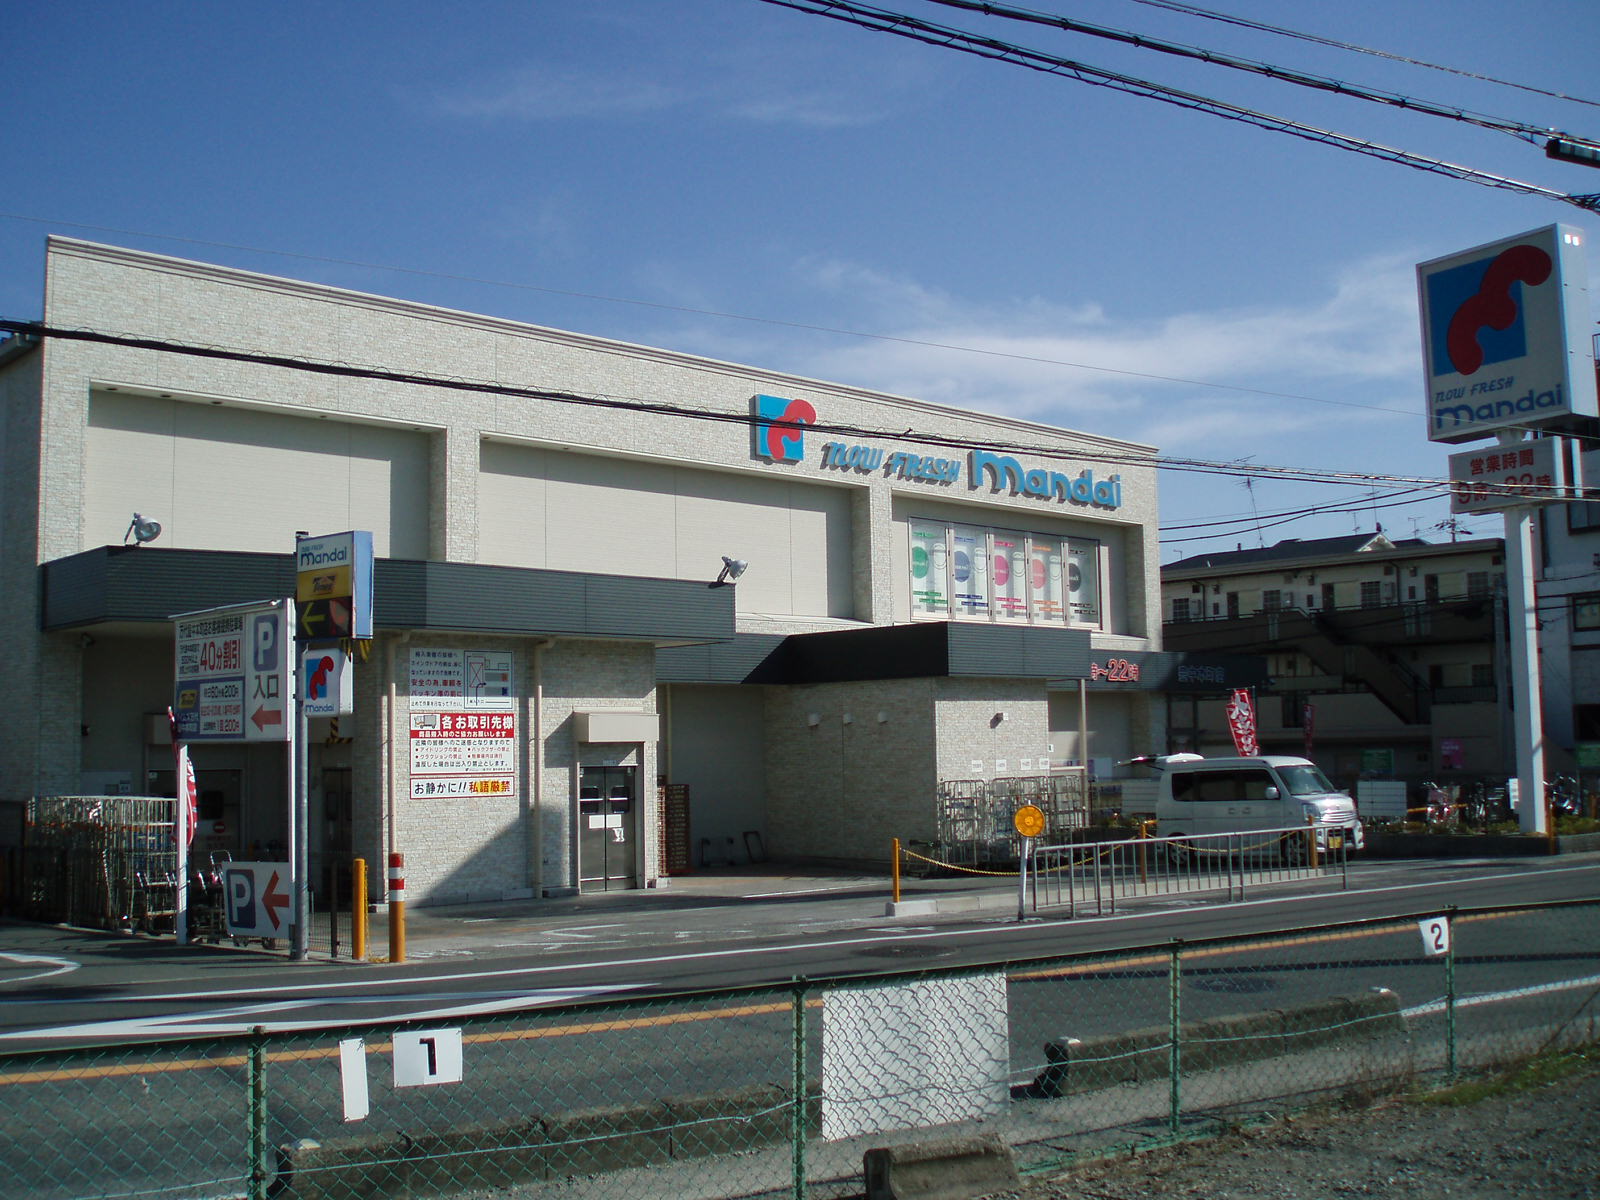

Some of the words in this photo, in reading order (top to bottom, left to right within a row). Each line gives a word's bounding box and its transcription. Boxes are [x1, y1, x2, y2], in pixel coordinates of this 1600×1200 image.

[1470, 376, 1514, 397] FRESH
[1435, 384, 1563, 429] mandai
[1470, 448, 1535, 476] 営業時間
[887, 451, 961, 483] FRESH
[972, 449, 1122, 508] mandai
[300, 546, 348, 567] mandai
[200, 639, 241, 672] 40分割引
[258, 621, 275, 665] P
[253, 674, 279, 699] 入口
[305, 703, 335, 713] mandai
[441, 715, 453, 729] 各
[455, 715, 513, 729] お取引先様
[230, 876, 251, 928] P
[1430, 923, 1444, 951] 2
[419, 1037, 437, 1076] 1
